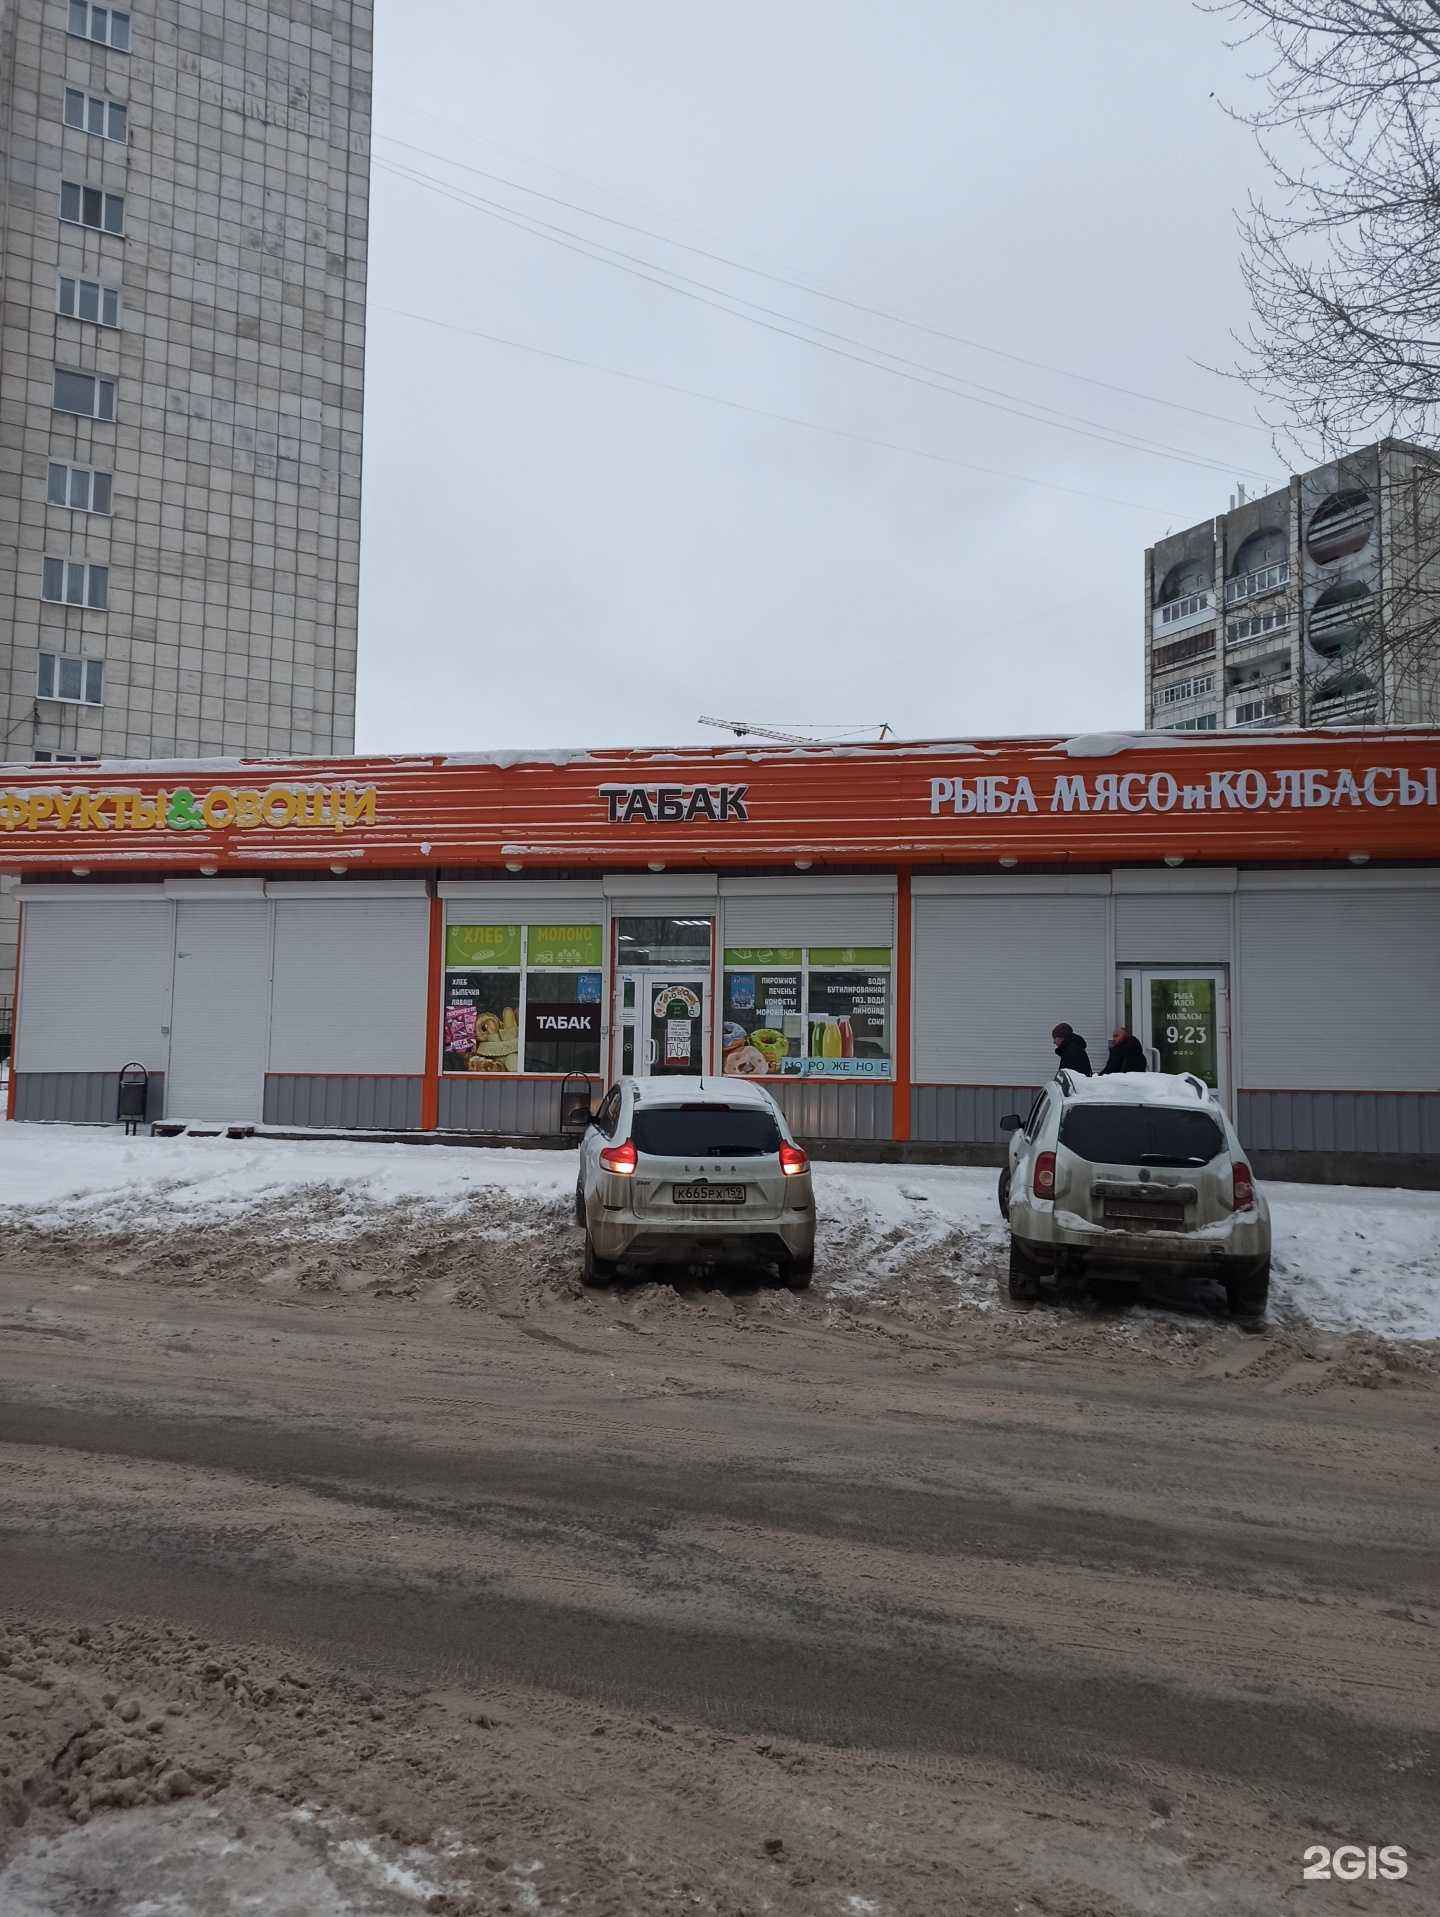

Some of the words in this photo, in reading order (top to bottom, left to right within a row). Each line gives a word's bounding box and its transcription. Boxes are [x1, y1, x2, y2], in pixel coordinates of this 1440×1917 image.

[929, 775, 1039, 815] РЫБА
[1050, 772, 1178, 812] МЯСО
[1209, 766, 1438, 808] КОЛБАСЫ
[598, 786, 749, 822] ТАБАК
[463, 926, 505, 944] ХЛЕБ
[538, 926, 592, 943] МОЛОКО
[451, 978, 469, 986] ХЛЕБ
[761, 977, 797, 985] ПИРОЖНОЕ
[867, 977, 886, 986] ВОДА
[451, 988, 480, 996] ВЫПЕЧКА
[768, 987, 797, 995] ПЕЧЕНЬЕ
[764, 998, 797, 1006] КОНФЕТЫ
[867, 996, 885, 1005] ВОДА
[852, 1007, 885, 1015] ЛИМОНАД
[536, 1016, 592, 1030] ТАБАК
[867, 1018, 885, 1026] СОКИ
[1166, 1026, 1207, 1044] 9-23
